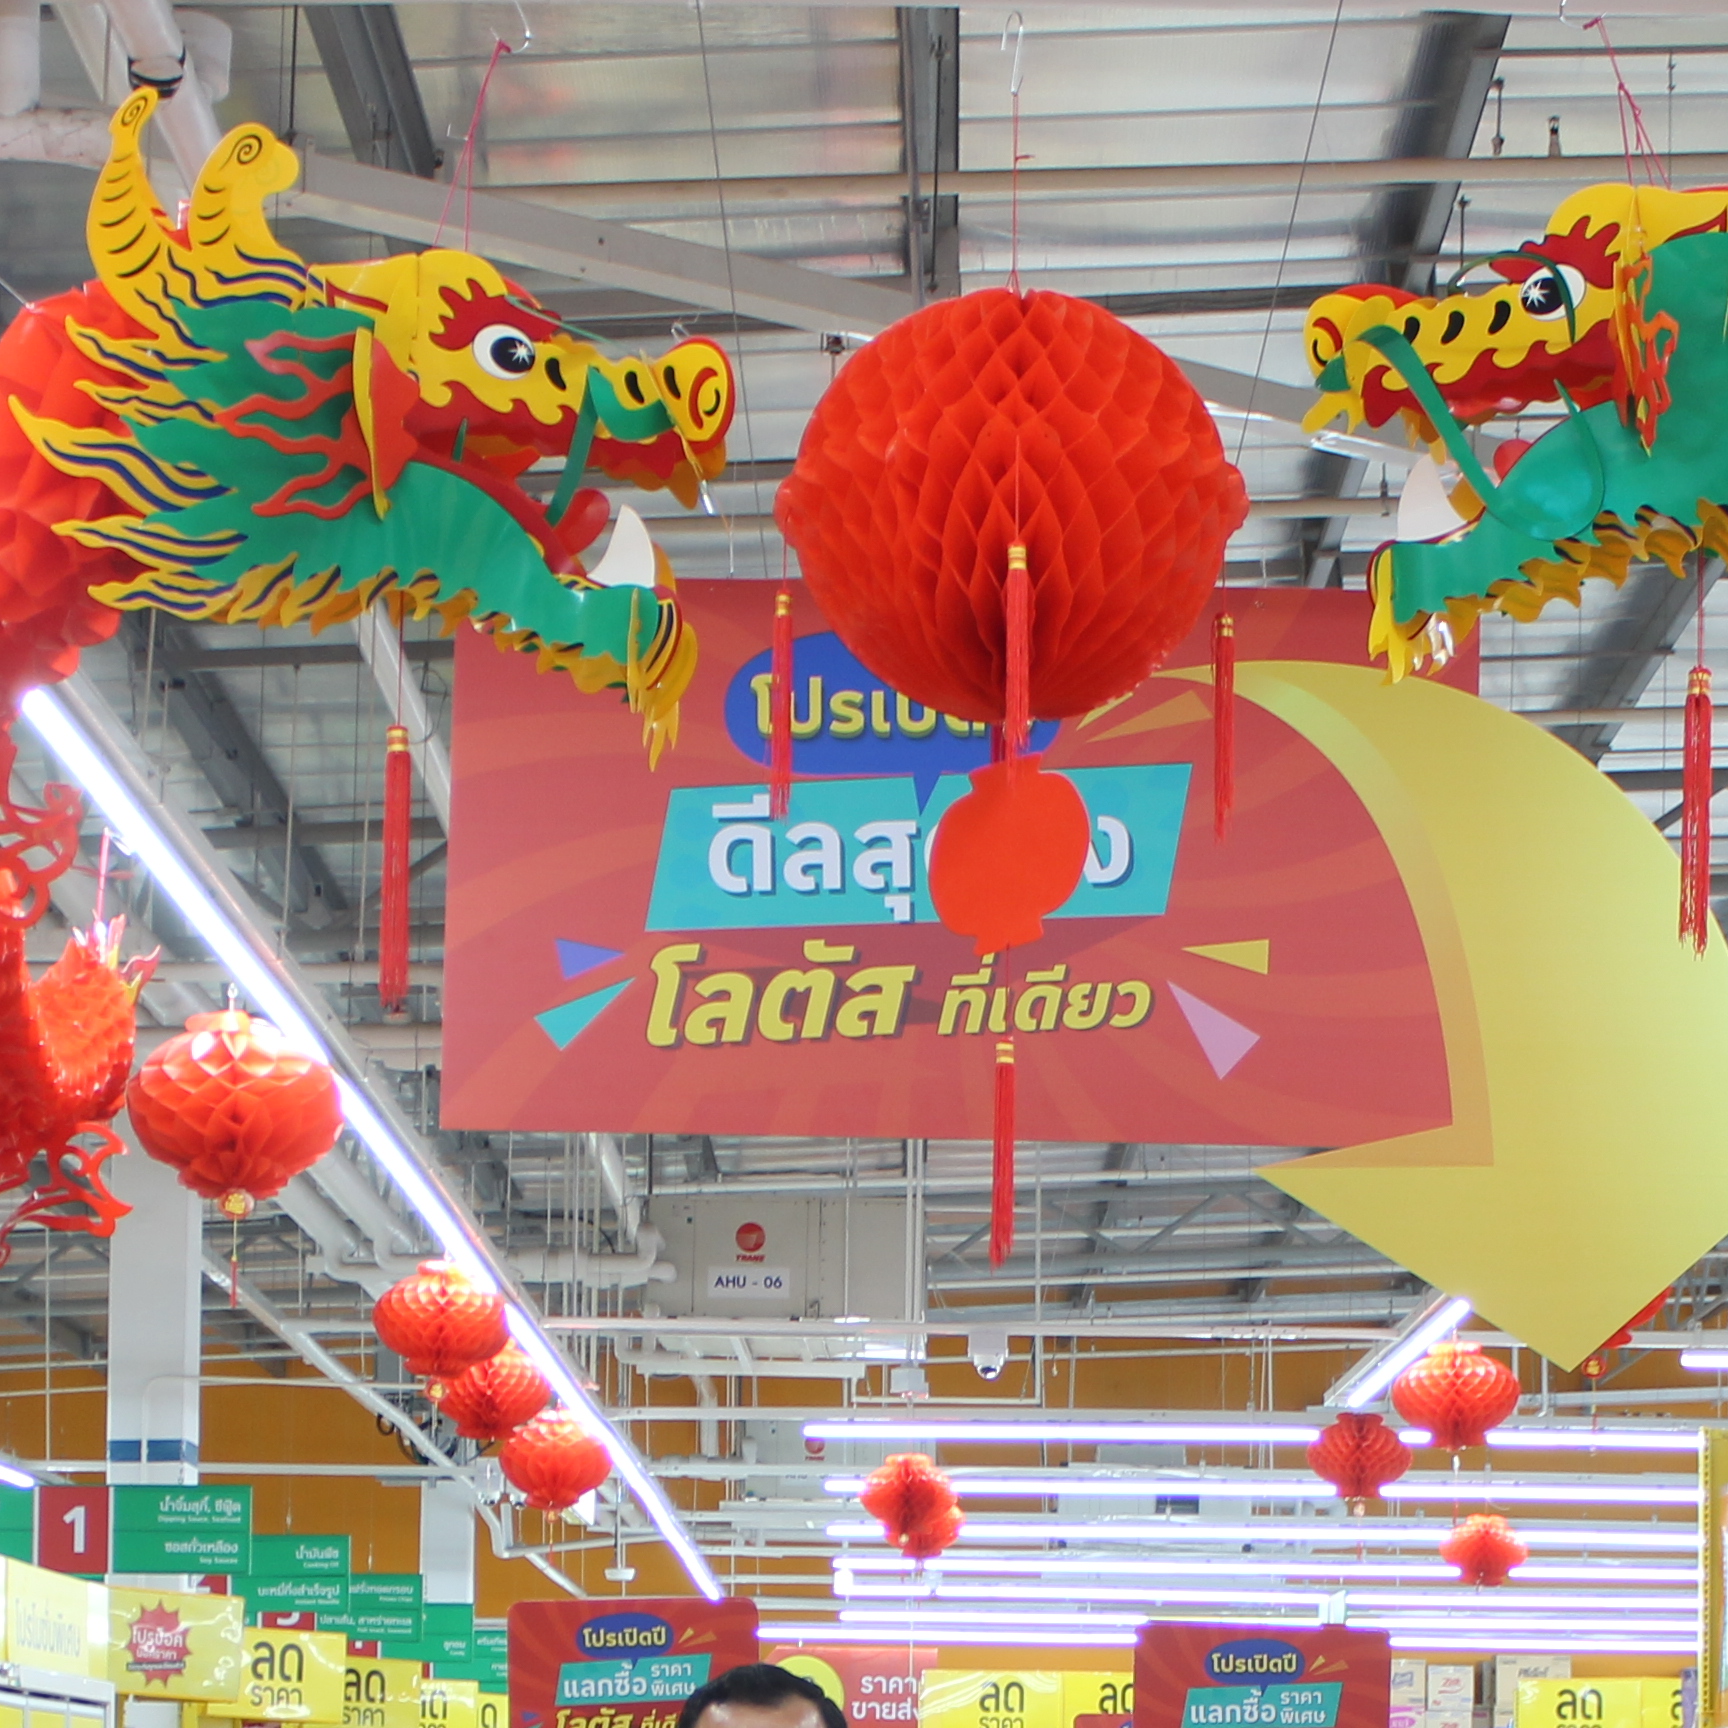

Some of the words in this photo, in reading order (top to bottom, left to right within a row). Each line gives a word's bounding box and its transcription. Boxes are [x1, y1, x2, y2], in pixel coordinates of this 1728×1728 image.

[645, 938, 916, 1050] โลตัส
[936, 950, 1155, 1036] ที่เดียว
[735, 1253, 767, 1264] TRANE
[714, 1275, 747, 1288] AHU
[763, 1276, 782, 1289] 06
[62, 1505, 86, 1554] 1
[164, 1539, 239, 1555] ซอสถั่วเหลือง
[295, 1543, 340, 1561] น้ำมันพืช
[582, 1626, 667, 1648] โปรเปิดปี
[250, 1641, 304, 1683] ลด
[651, 1663, 692, 1678] ราคา
[1211, 1653, 1298, 1674] โปรเปิดปี
[344, 1668, 386, 1705] ลด
[562, 1660, 647, 1699] แลกซื้อ
[651, 1678, 696, 1697] พิเศษ
[860, 1675, 917, 1695] ราคา
[250, 1685, 303, 1708] ราคา
[978, 1680, 1025, 1714] ลด
[1190, 1688, 1277, 1725] แลกซื้อ
[1280, 1691, 1322, 1706] ราคา
[1555, 1688, 1603, 1721] ลด
[342, 1707, 385, 1728] ราคา
[1280, 1707, 1327, 1725] พิเศษ
